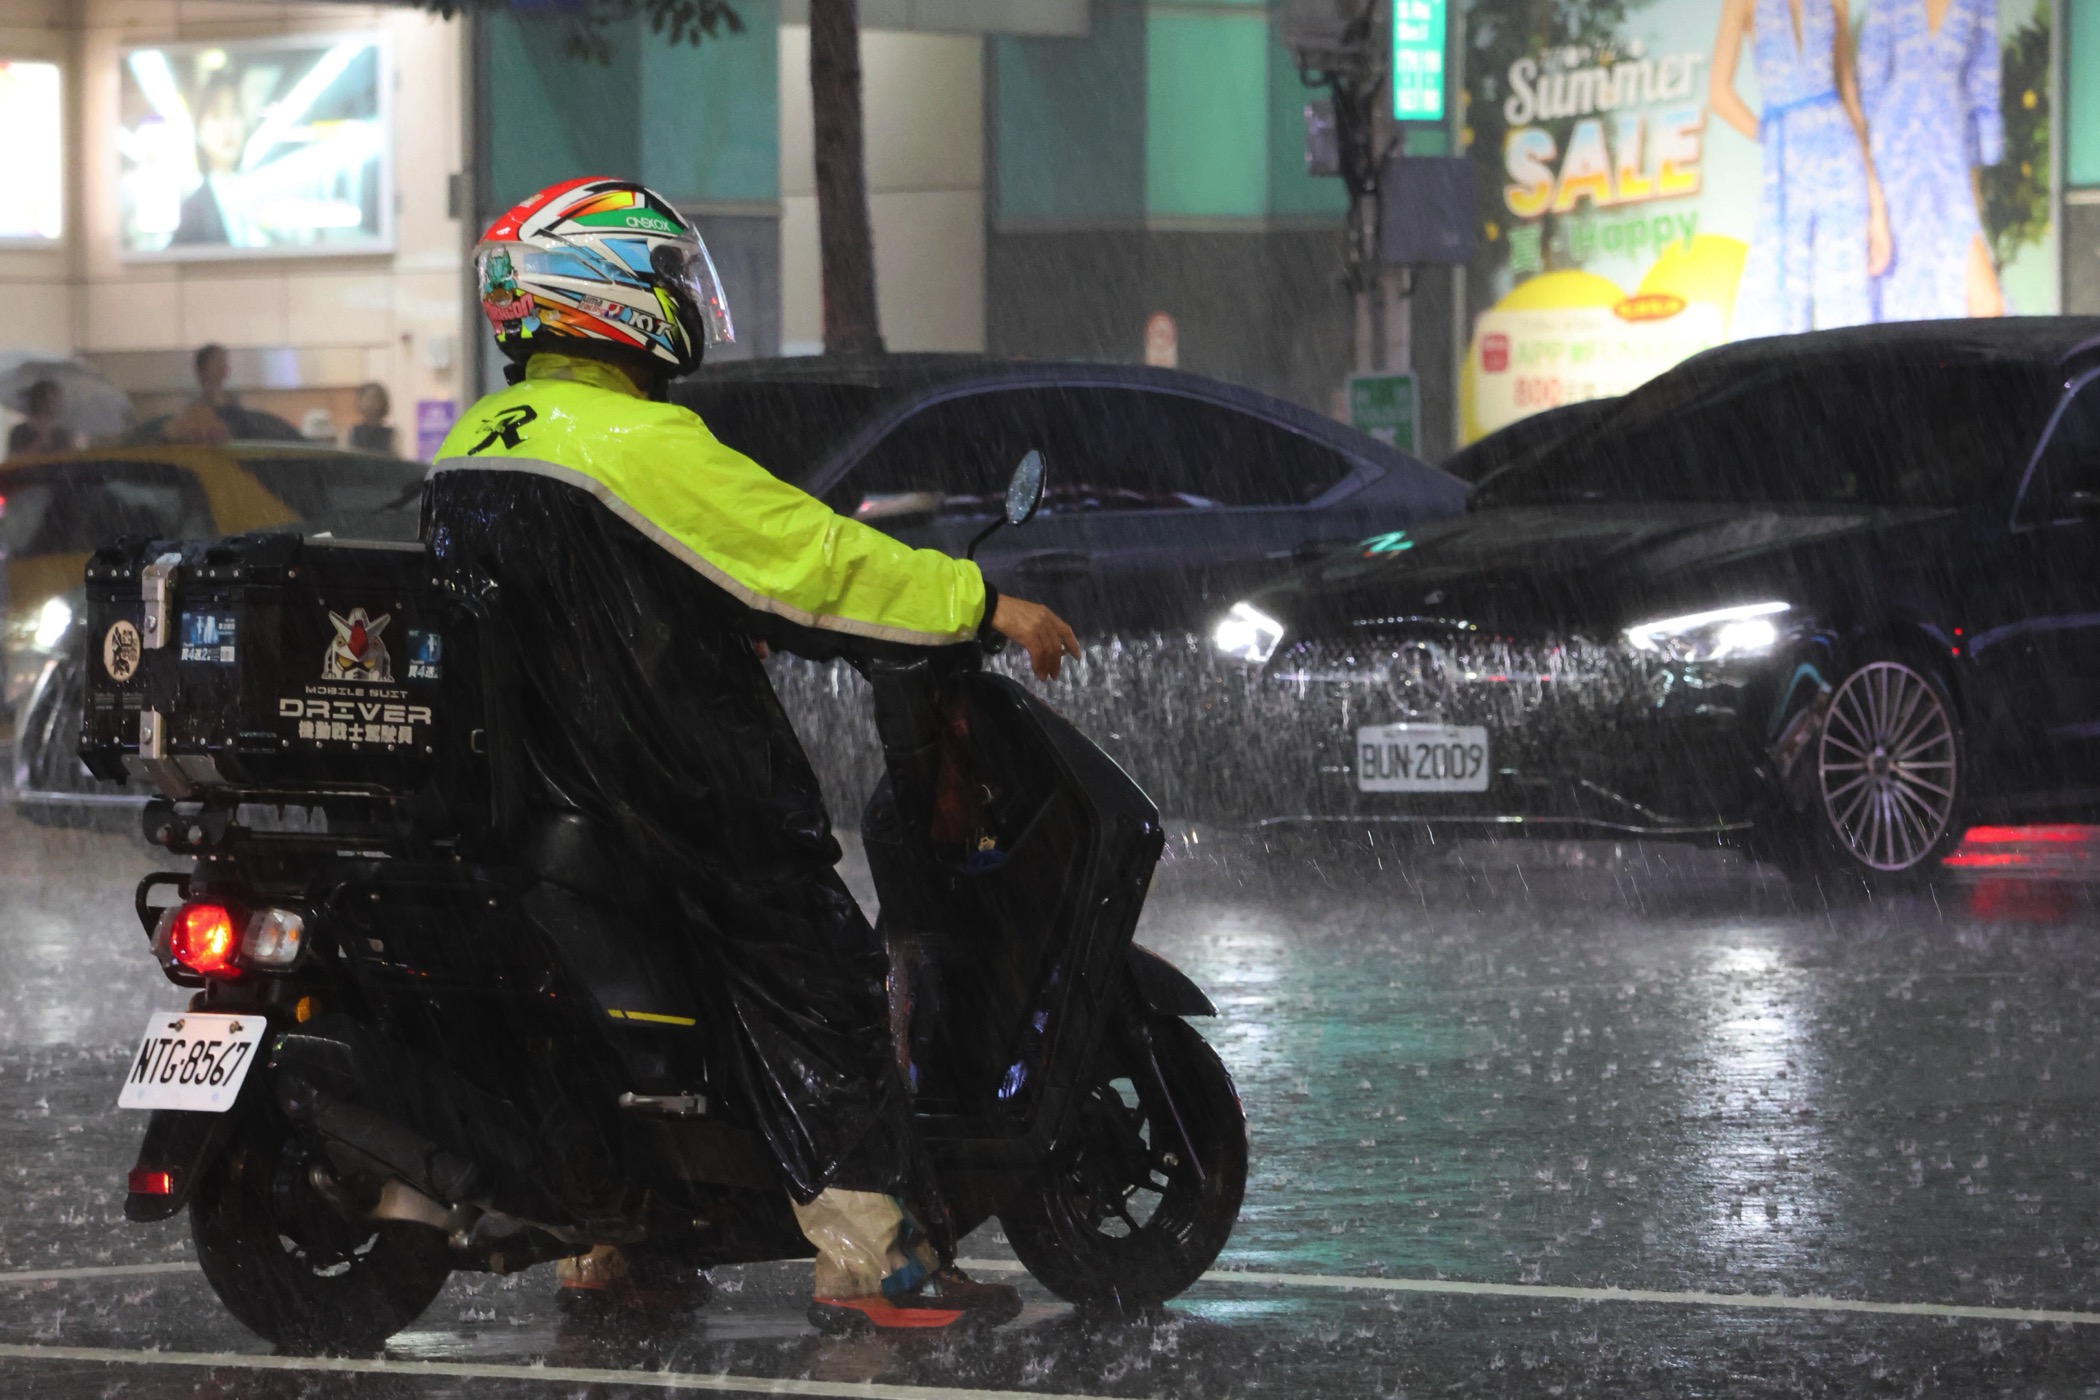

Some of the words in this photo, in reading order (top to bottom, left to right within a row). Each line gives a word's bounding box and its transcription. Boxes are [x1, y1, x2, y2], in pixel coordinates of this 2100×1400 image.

[1504, 54, 1703, 126] Summer
[1504, 107, 1704, 220] SALE
[1568, 210, 1699, 262] Happy
[279, 698, 432, 725] DRIVER
[305, 685, 364, 697] MOBILE
[369, 689, 408, 699] SUIT
[1361, 743, 1484, 780] BUN-2009
[130, 1037, 252, 1087] NTG-8567
